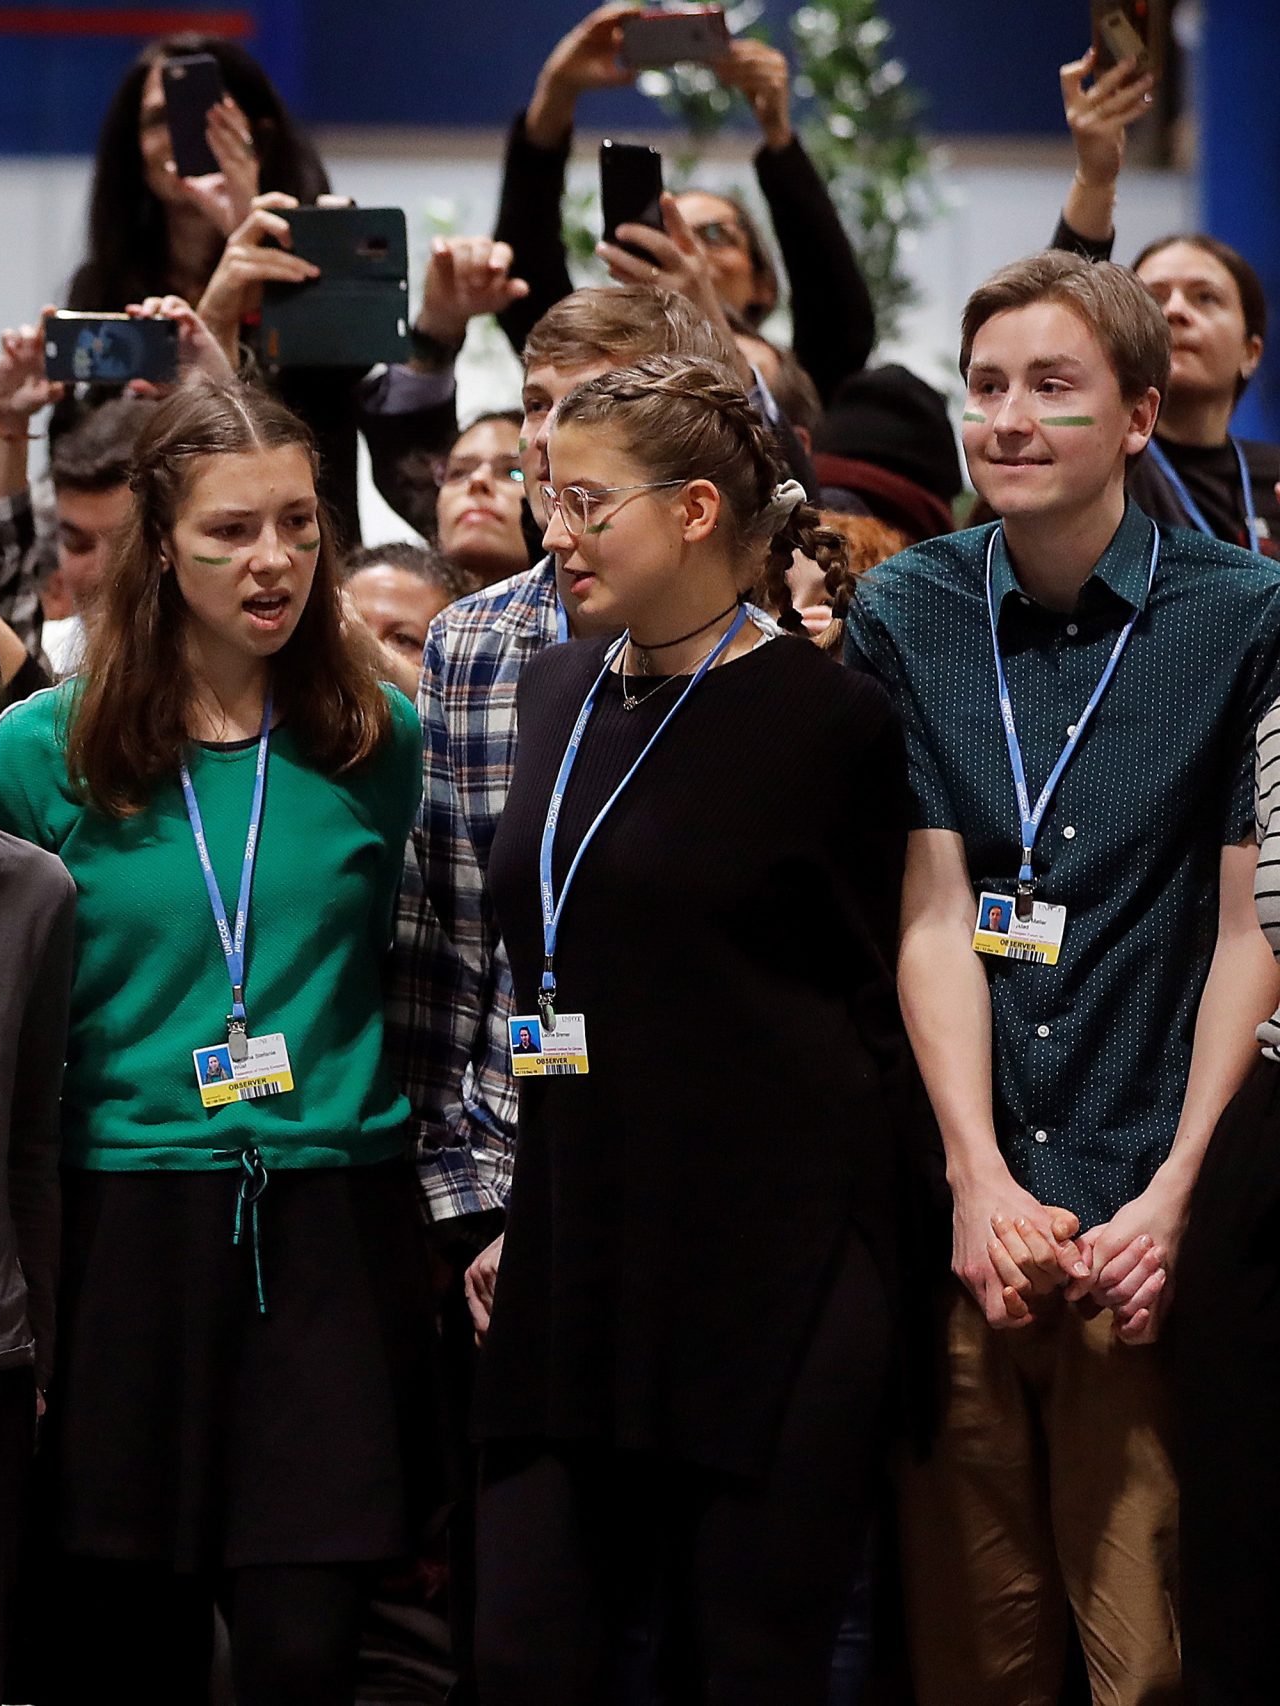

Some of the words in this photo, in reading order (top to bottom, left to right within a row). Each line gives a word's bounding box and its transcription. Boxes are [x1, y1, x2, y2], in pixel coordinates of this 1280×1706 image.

[1001, 699, 1016, 734] UNFCCC
[547, 793, 563, 829] UNFCCC
[1031, 789, 1050, 825] UNFCCC
[245, 824, 258, 860] UNFCCC
[542, 881, 552, 925] unfccc.int
[217, 918, 233, 956] UNFCCC
[234, 911, 245, 953] unfccc.int
[1000, 938, 1037, 951] OBSERVER
[536, 1057, 568, 1065] OBSERVER
[228, 1077, 267, 1091] OBSERVER
